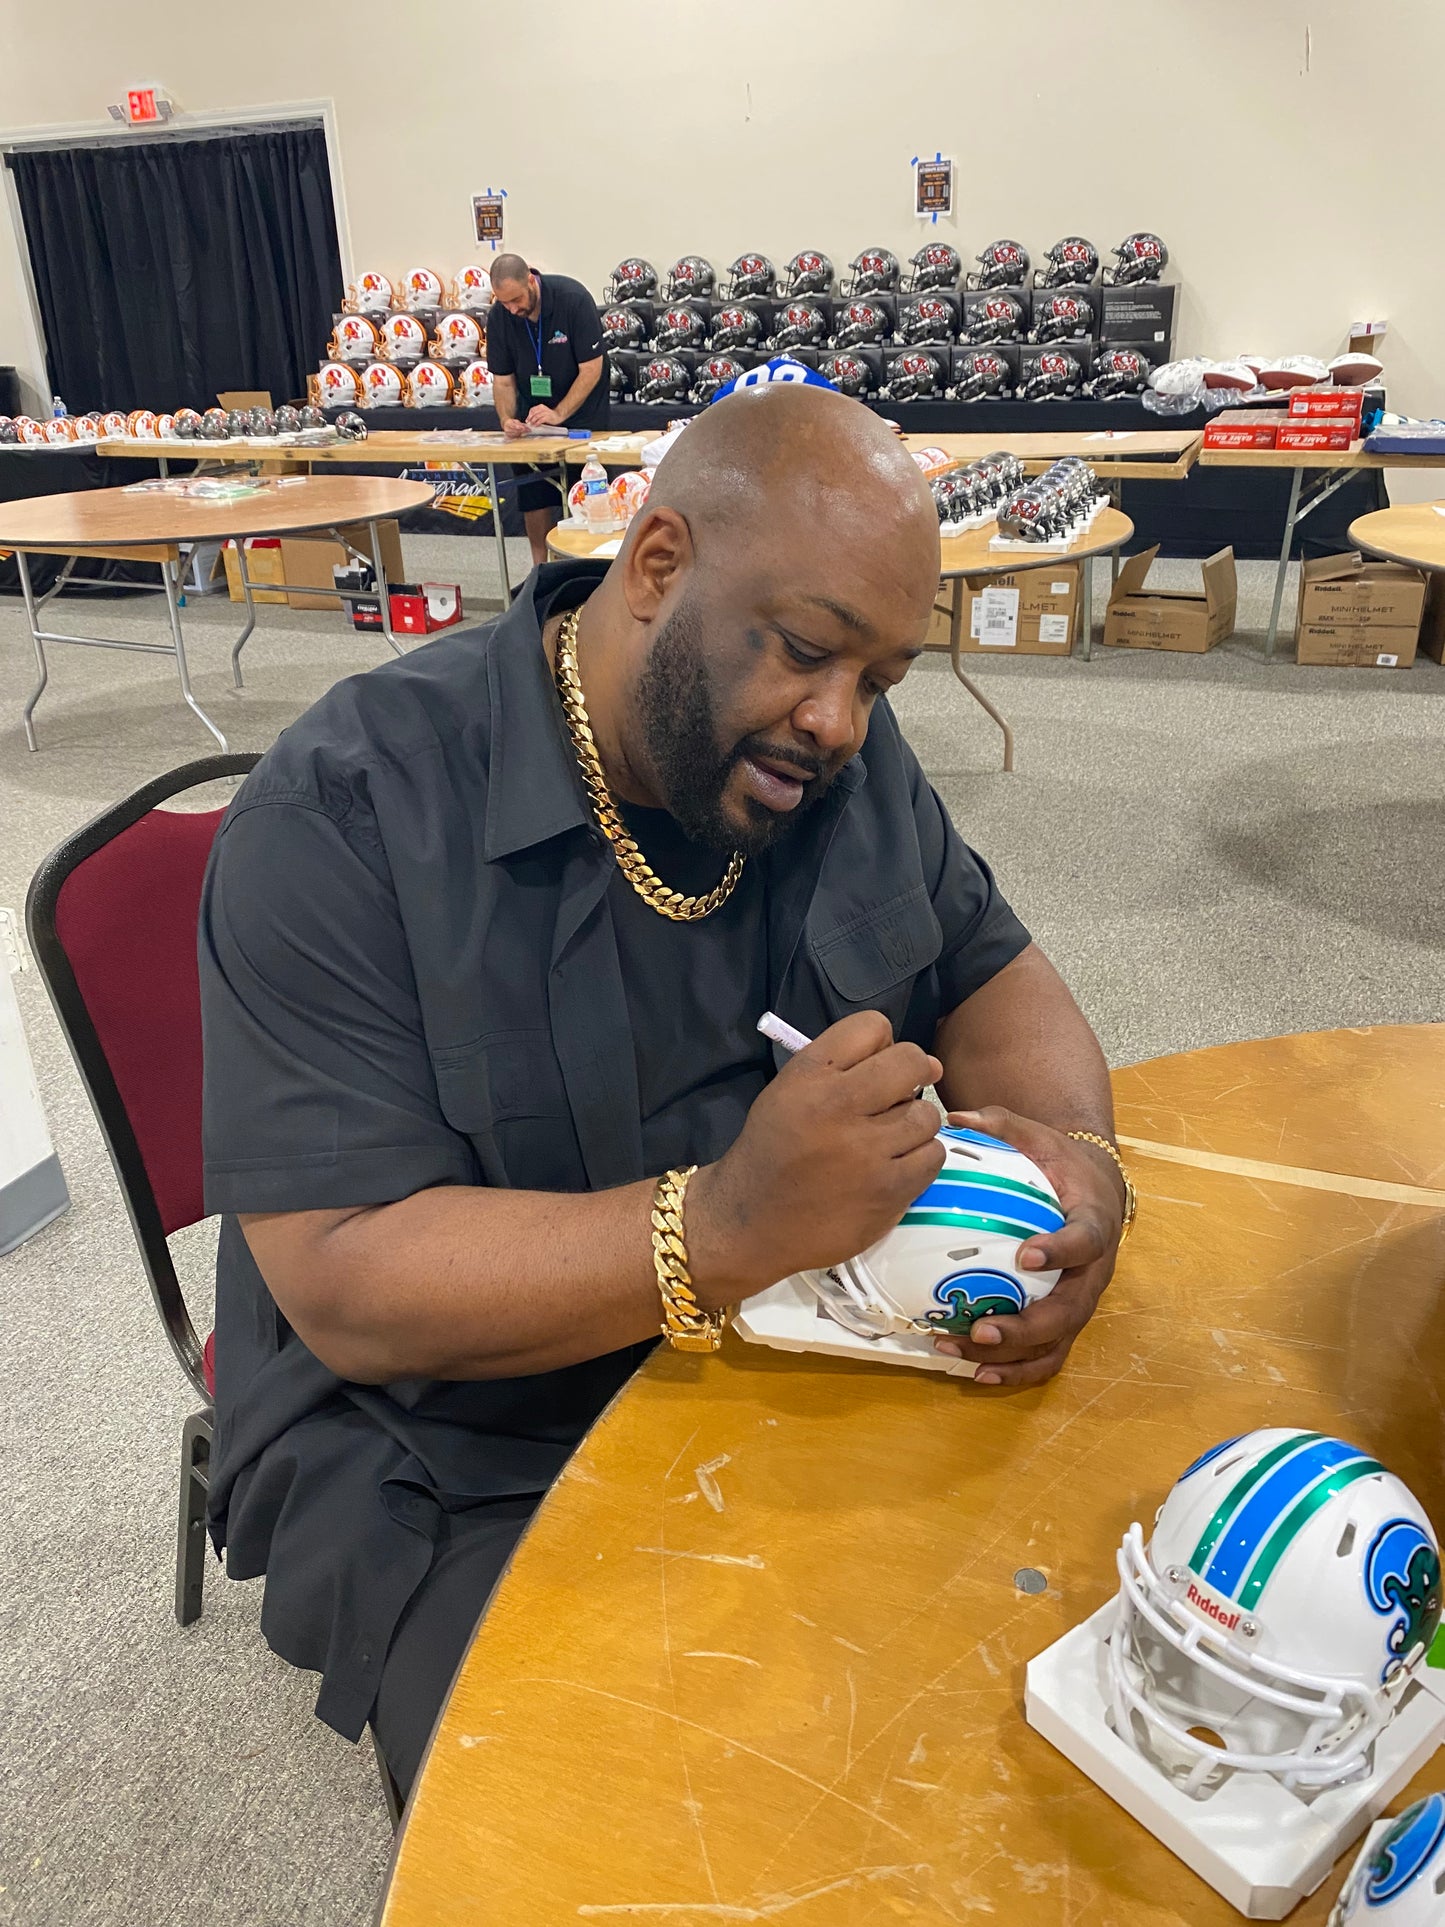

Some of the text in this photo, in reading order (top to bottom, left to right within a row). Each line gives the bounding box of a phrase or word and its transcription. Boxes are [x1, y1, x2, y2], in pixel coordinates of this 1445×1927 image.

[129, 90, 156, 121] EXIT
[411, 472, 484, 480] PALM BEAH
[1112, 610, 1137, 618] Riddell
[1187, 1584, 1241, 1631] Riddell
